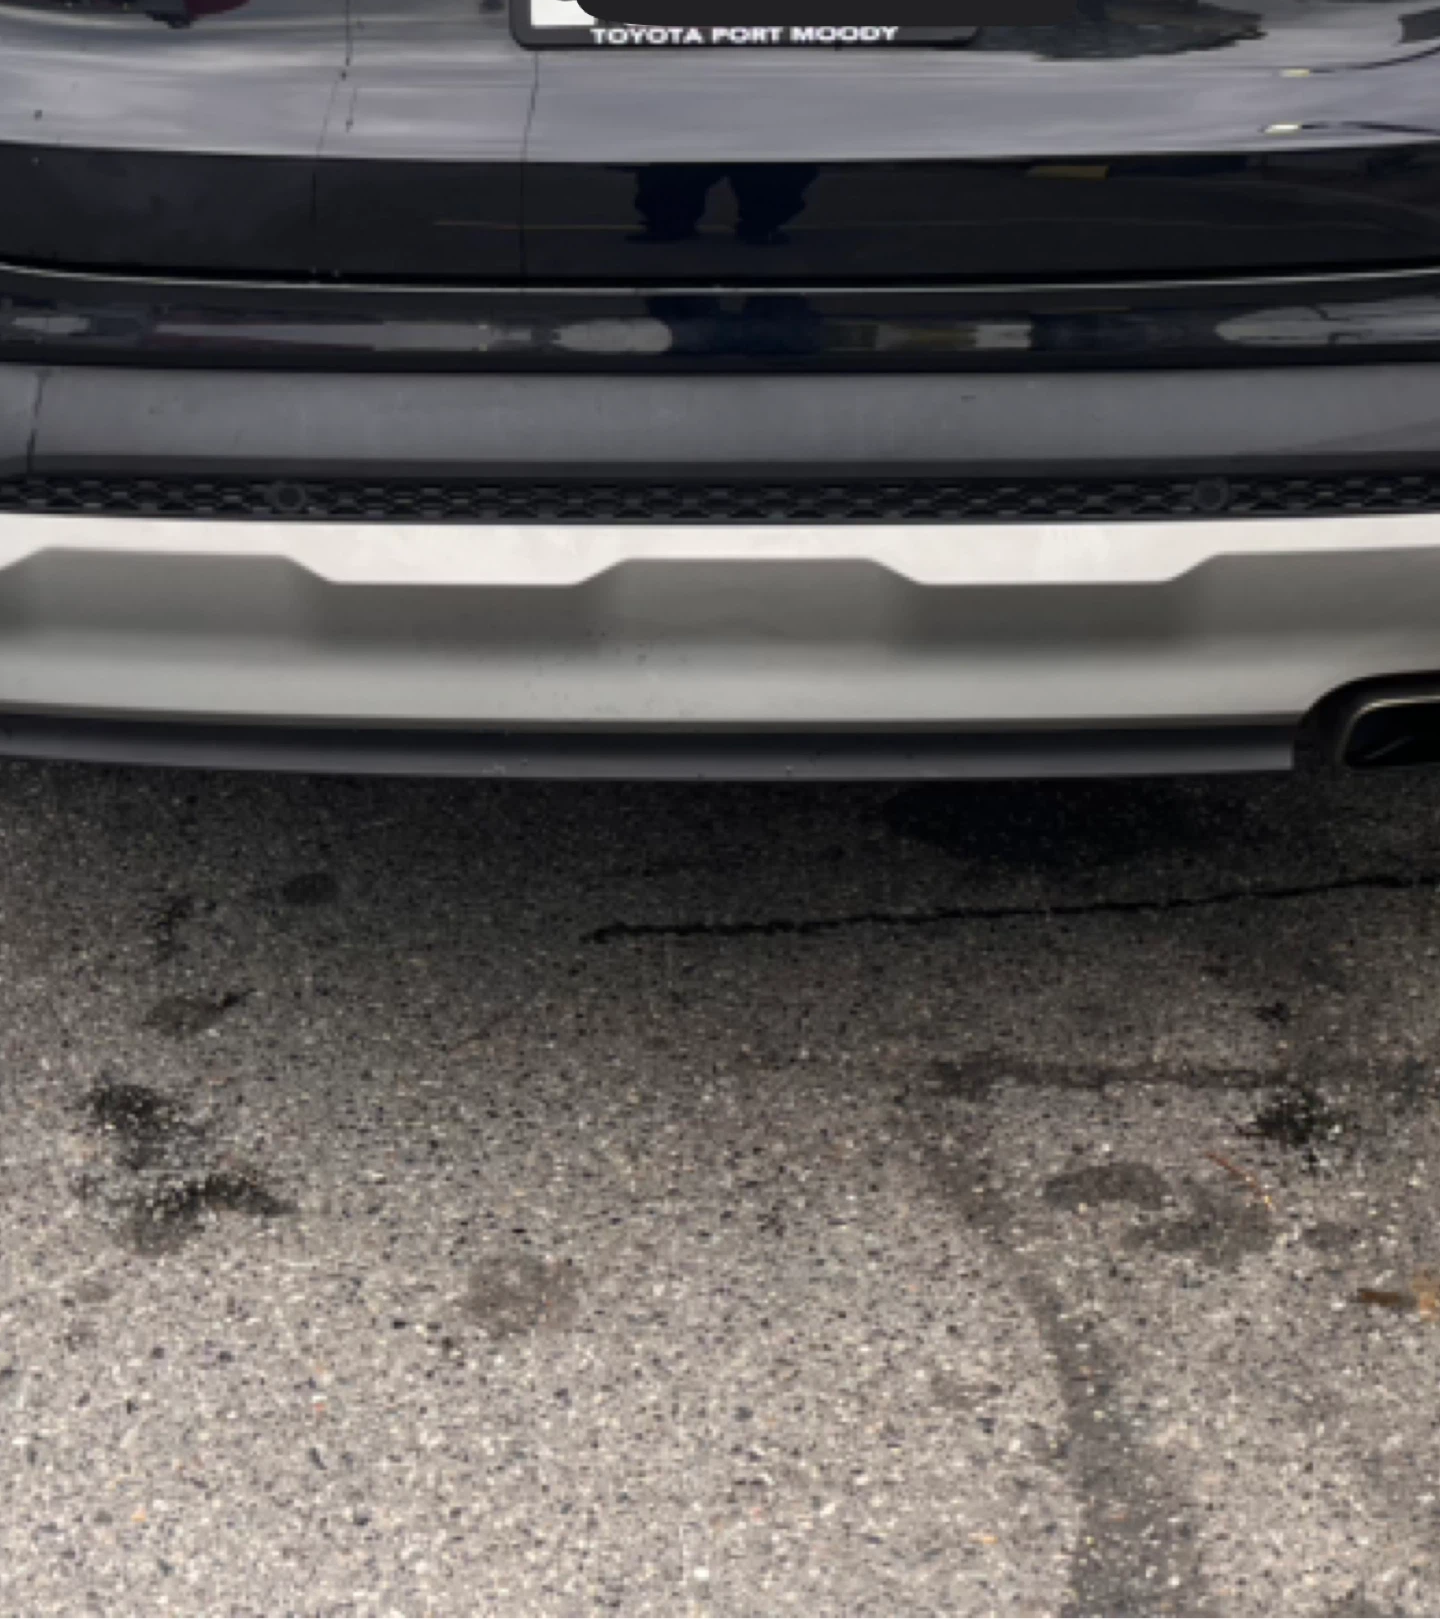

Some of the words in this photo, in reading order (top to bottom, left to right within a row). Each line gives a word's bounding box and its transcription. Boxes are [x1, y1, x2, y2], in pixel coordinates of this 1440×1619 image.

[590, 26, 705, 45] TOYOTA
[711, 26, 784, 44] PORT
[790, 25, 899, 43] MOODY
